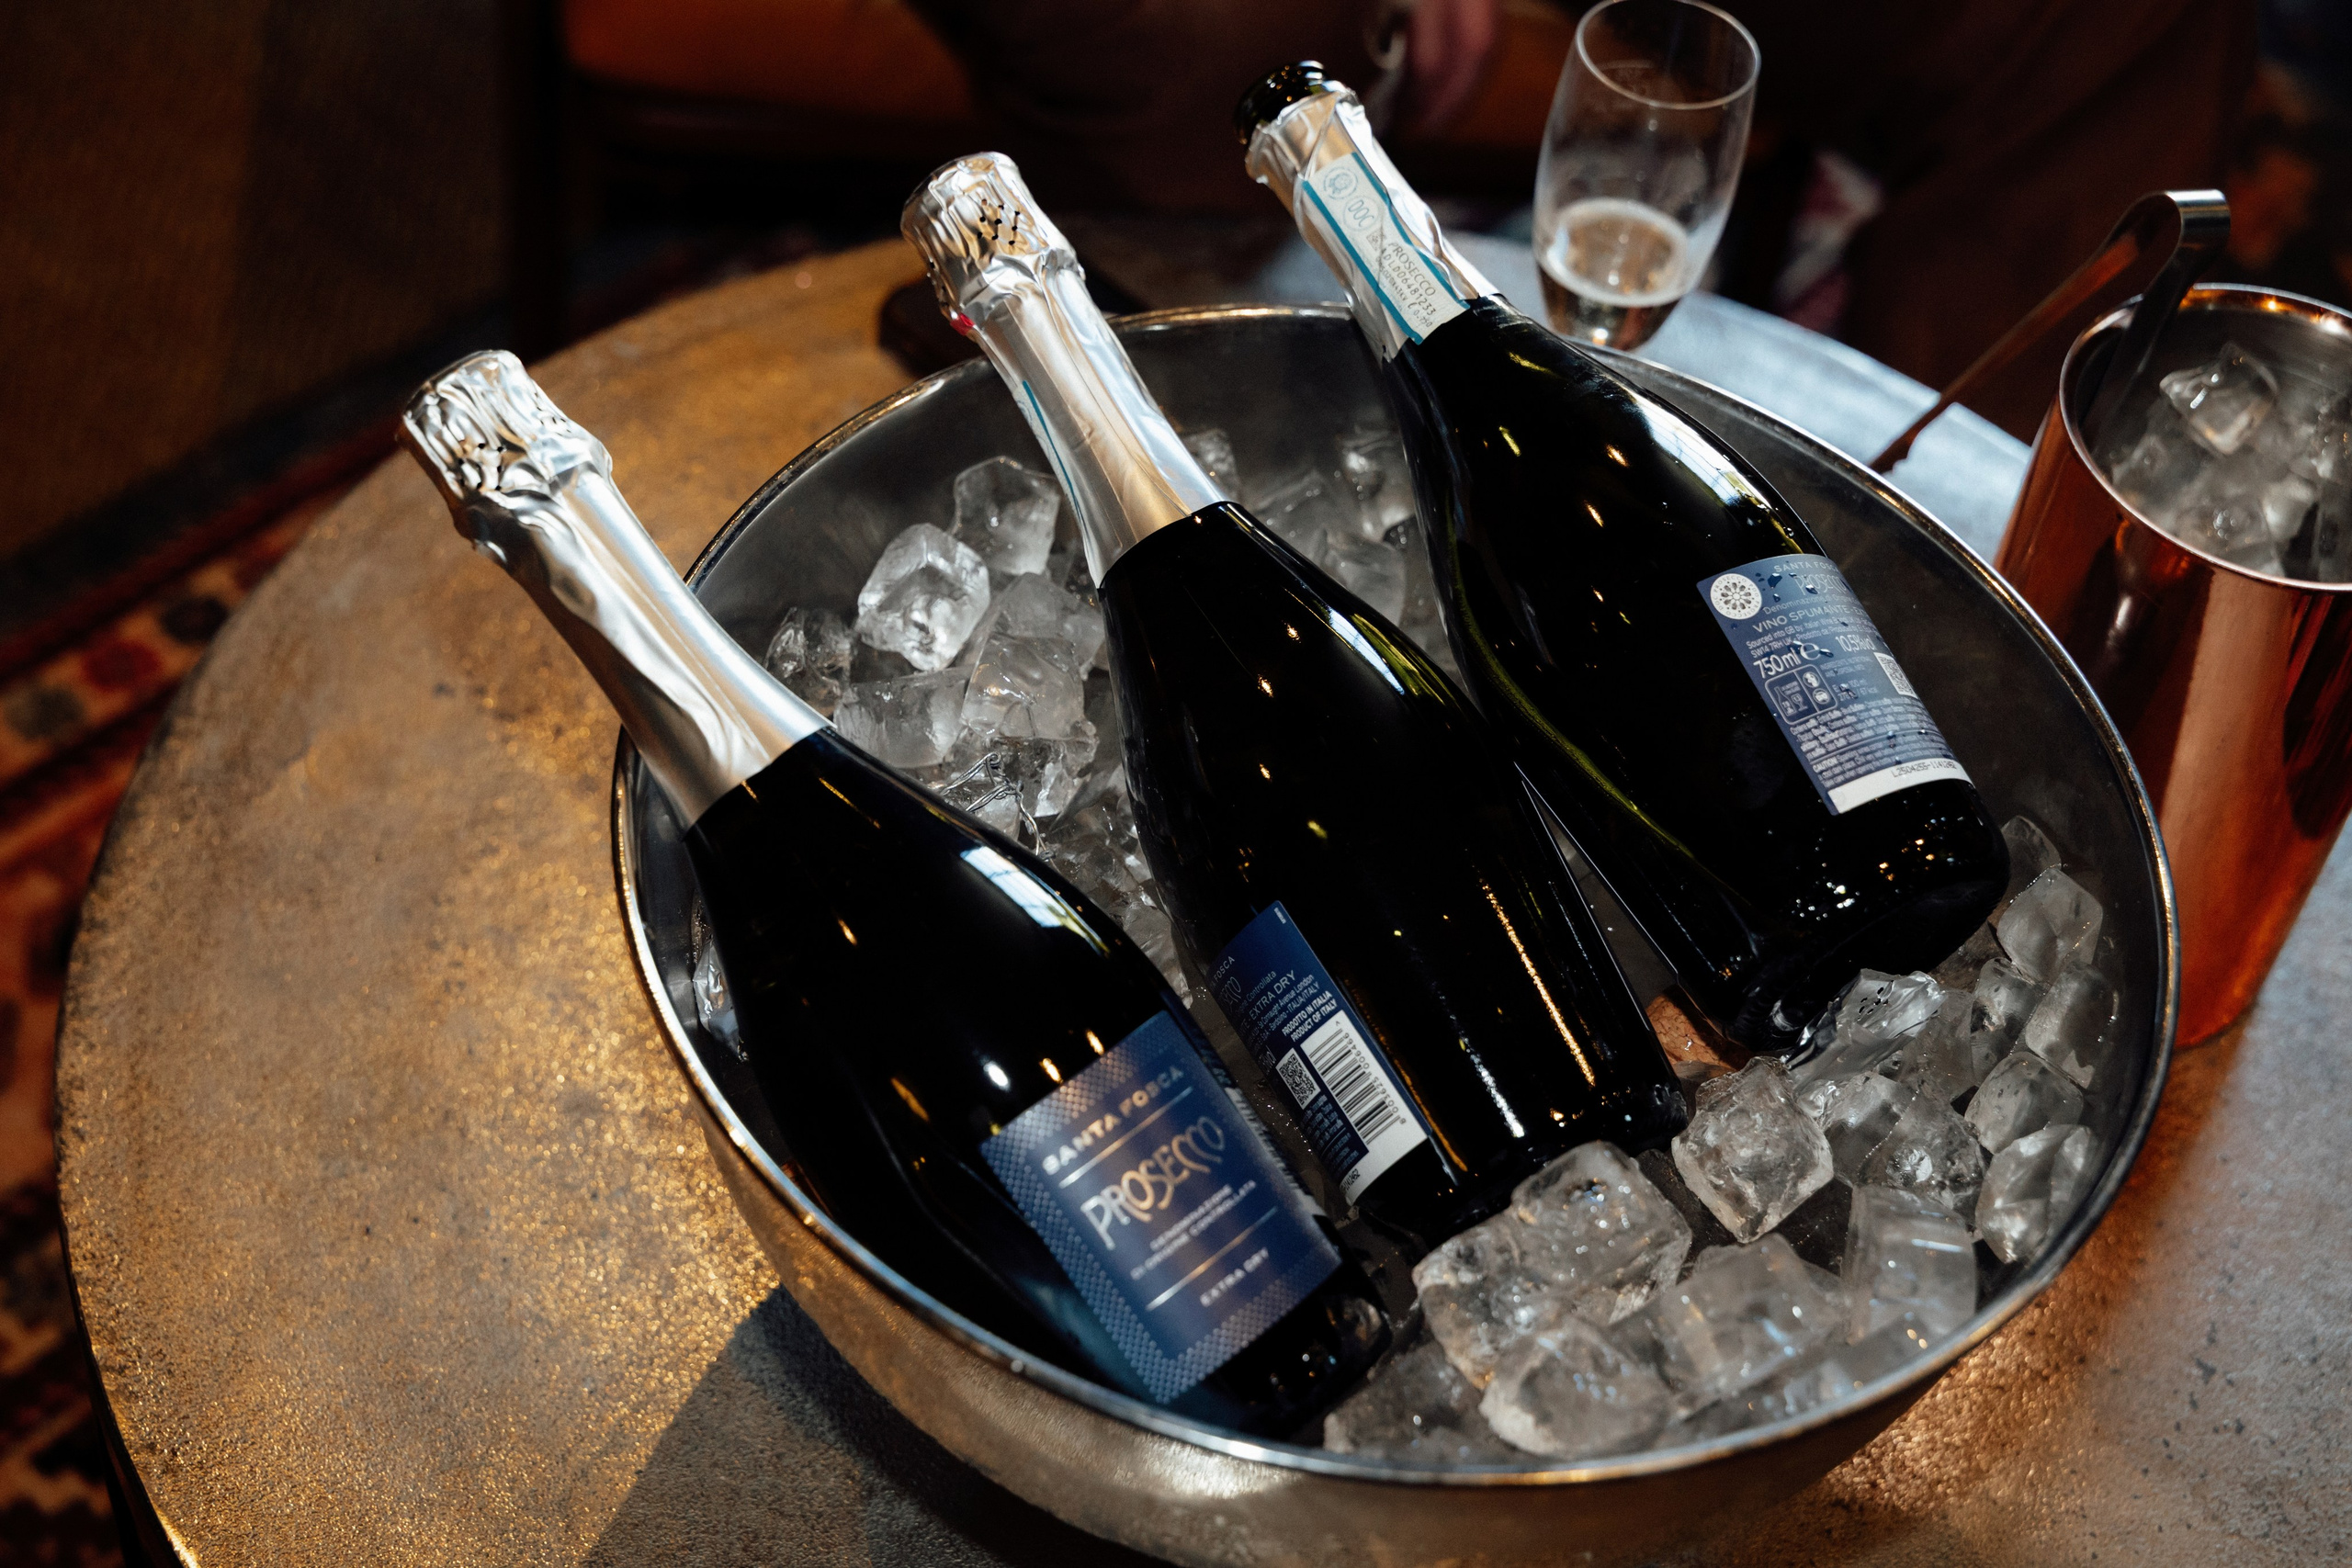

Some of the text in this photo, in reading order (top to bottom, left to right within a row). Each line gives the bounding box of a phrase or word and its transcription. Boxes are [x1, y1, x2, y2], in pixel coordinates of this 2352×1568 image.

[1345, 198, 1375, 228] DOC
[1386, 240, 1437, 299] PROSECCO
[1773, 561, 1812, 573] SANTA
[1746, 632, 1772, 649] Sourced
[1772, 628, 1785, 639] into
[1784, 626, 1795, 635] GB
[1751, 614, 1788, 634] VINO
[1788, 604, 1849, 622] SPUMANTE
[1750, 645, 1770, 659] SW14
[1768, 639, 1784, 651] 7RH
[1212, 954, 1236, 981] FOSCA
[1244, 969, 1277, 1002] Controllata
[1248, 990, 1276, 1020] EXTRA
[1272, 969, 1297, 995] DRY
[1267, 1010, 1288, 1032] Bardolino
[1285, 980, 1321, 1012] ITALIA/ITALY
[1277, 987, 1297, 1008] Avenue
[1293, 973, 1315, 993] London
[1281, 988, 1333, 1036] PRODOTTO IN ITALIA
[1289, 997, 1339, 1042] PRODUCT OF ITALY
[1341, 1032, 1407, 1125] 8 003625 006466
[1038, 1064, 1185, 1177] SANTA FOSCA
[1078, 1116, 1225, 1251] PROSECCO
[1198, 1246, 1272, 1308] EXTRA DRY
